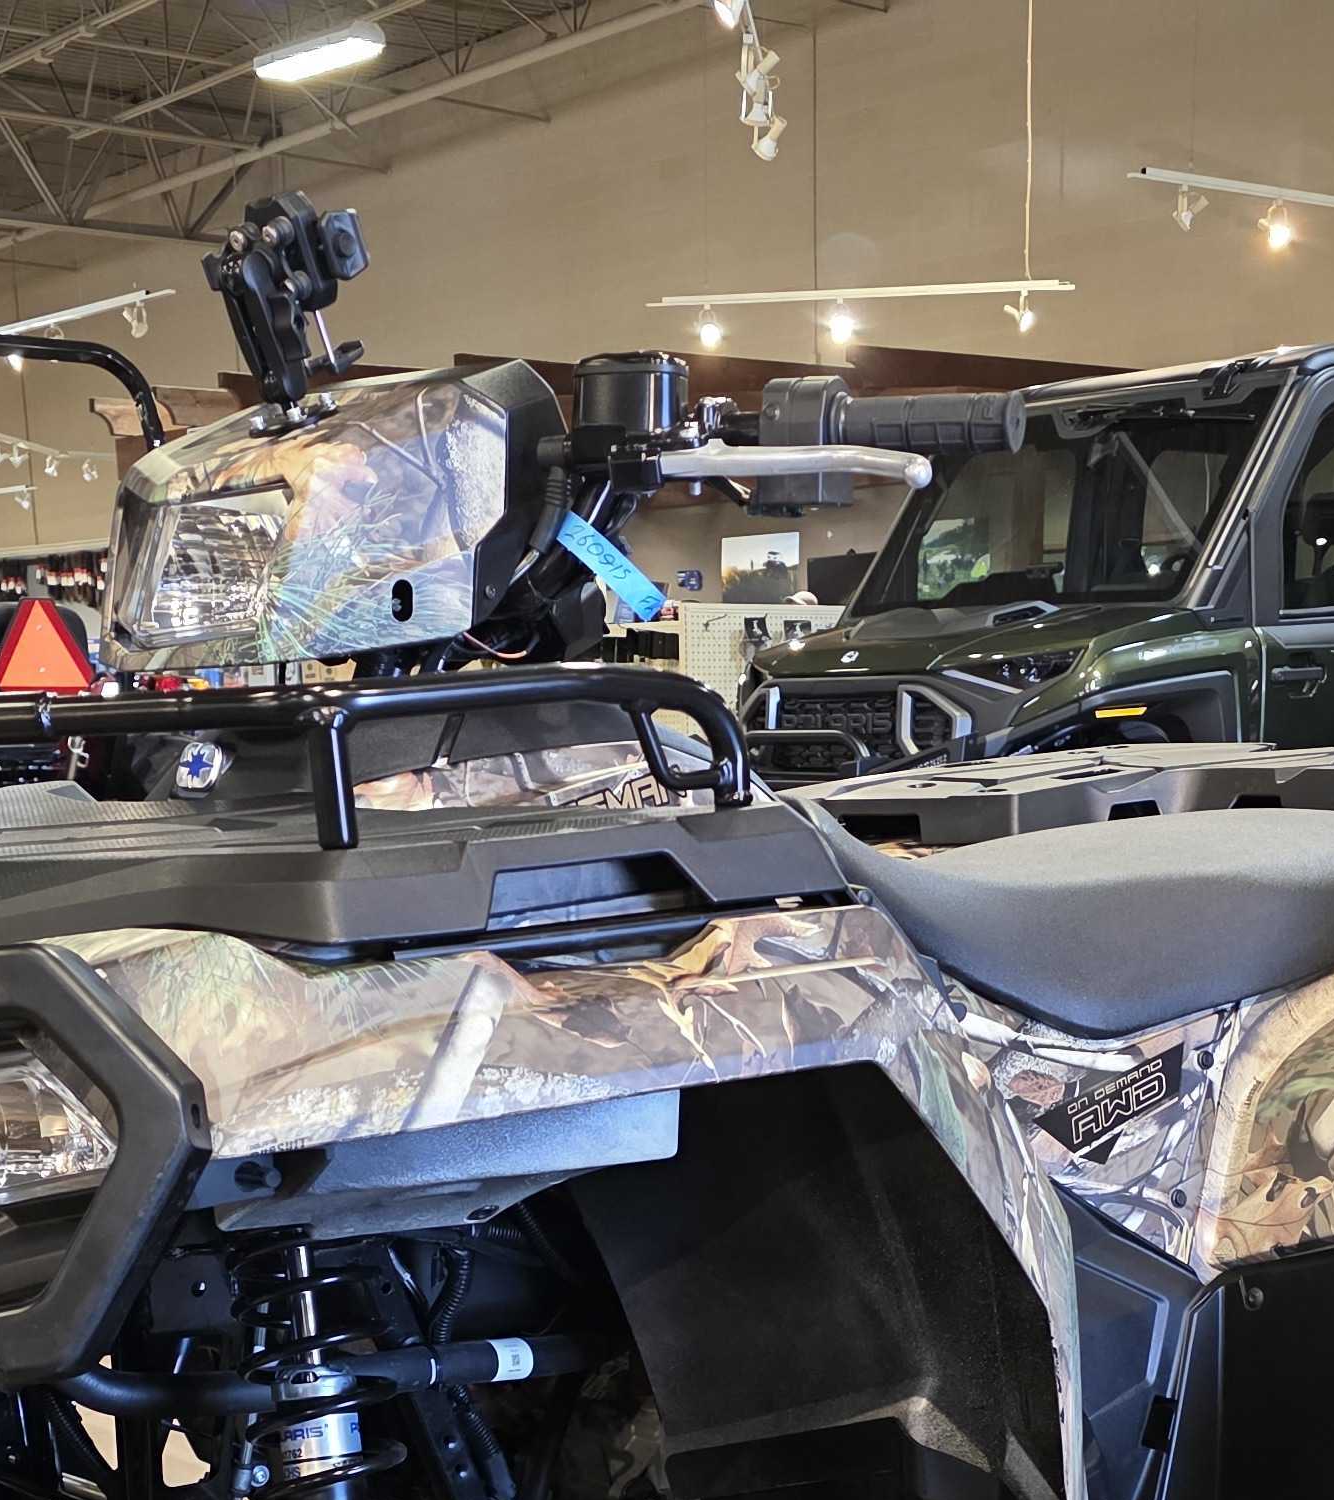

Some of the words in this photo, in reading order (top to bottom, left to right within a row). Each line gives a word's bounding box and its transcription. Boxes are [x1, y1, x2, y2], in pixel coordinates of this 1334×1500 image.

[781, 712, 893, 735] POLARIS
[1067, 1096, 1089, 1115] ON
[1094, 1059, 1163, 1101] DEMAND
[1071, 1072, 1166, 1145] AWD
